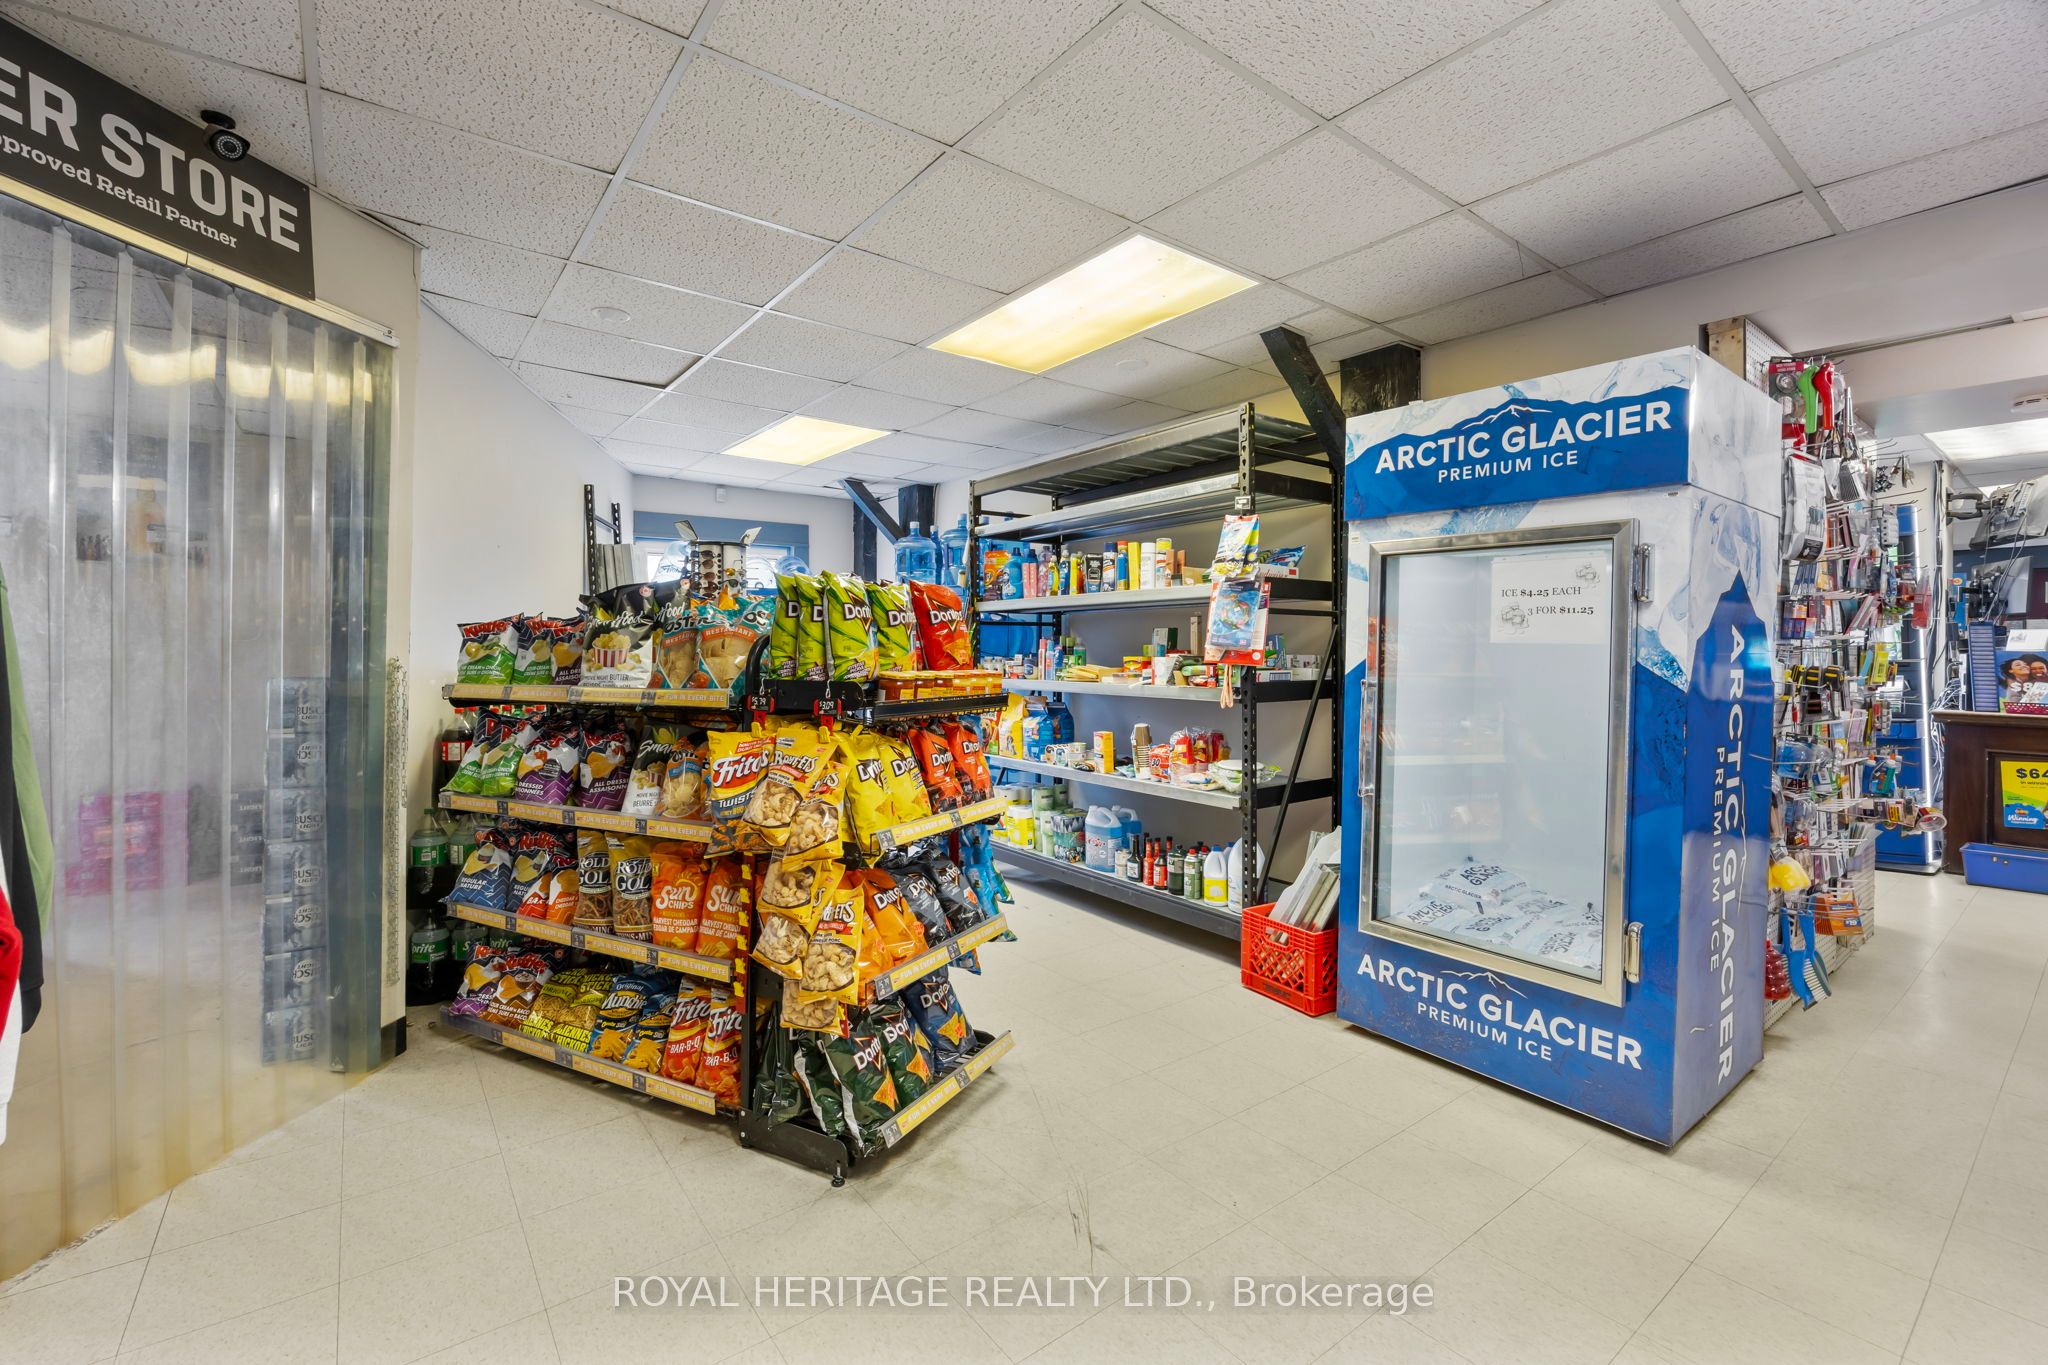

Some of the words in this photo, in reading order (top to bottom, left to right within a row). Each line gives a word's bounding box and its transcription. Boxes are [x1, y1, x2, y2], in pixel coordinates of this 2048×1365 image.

[101, 113, 300, 253] STORE
[96, 174, 162, 216] Retail
[165, 205, 238, 248] Partner
[1375, 431, 1491, 474] ARCTIC
[1501, 400, 1672, 454] GLACIER
[1437, 457, 1532, 483] PREMIUM
[1542, 450, 1579, 470] ICE
[1501, 588, 1518, 598] ICE
[1520, 588, 1549, 598] $4.25
[1552, 586, 1582, 596] EACH
[1527, 607, 1533, 616] 3
[1535, 605, 1557, 615] FOR
[1558, 605, 1595, 615] $11.25
[1724, 624, 1745, 832] ARCTIC
[637, 740, 674, 758] Smar
[712, 750, 770, 787] Fritos
[1711, 746, 1726, 903] PREMIUM
[655, 885, 697, 910] Sun
[667, 902, 694, 910] CHIPS
[673, 918, 698, 926] CHEDDAR
[1709, 919, 1721, 973] ICE
[1718, 848, 1738, 1087] GLACIER
[671, 998, 712, 1027] Frito
[708, 1007, 742, 1038] Frito
[1357, 953, 1468, 1010] ARCTIC
[1478, 993, 1643, 1071] GLACIER
[1417, 1001, 1507, 1045] PREMIUM
[1518, 1036, 1552, 1061] ICE
